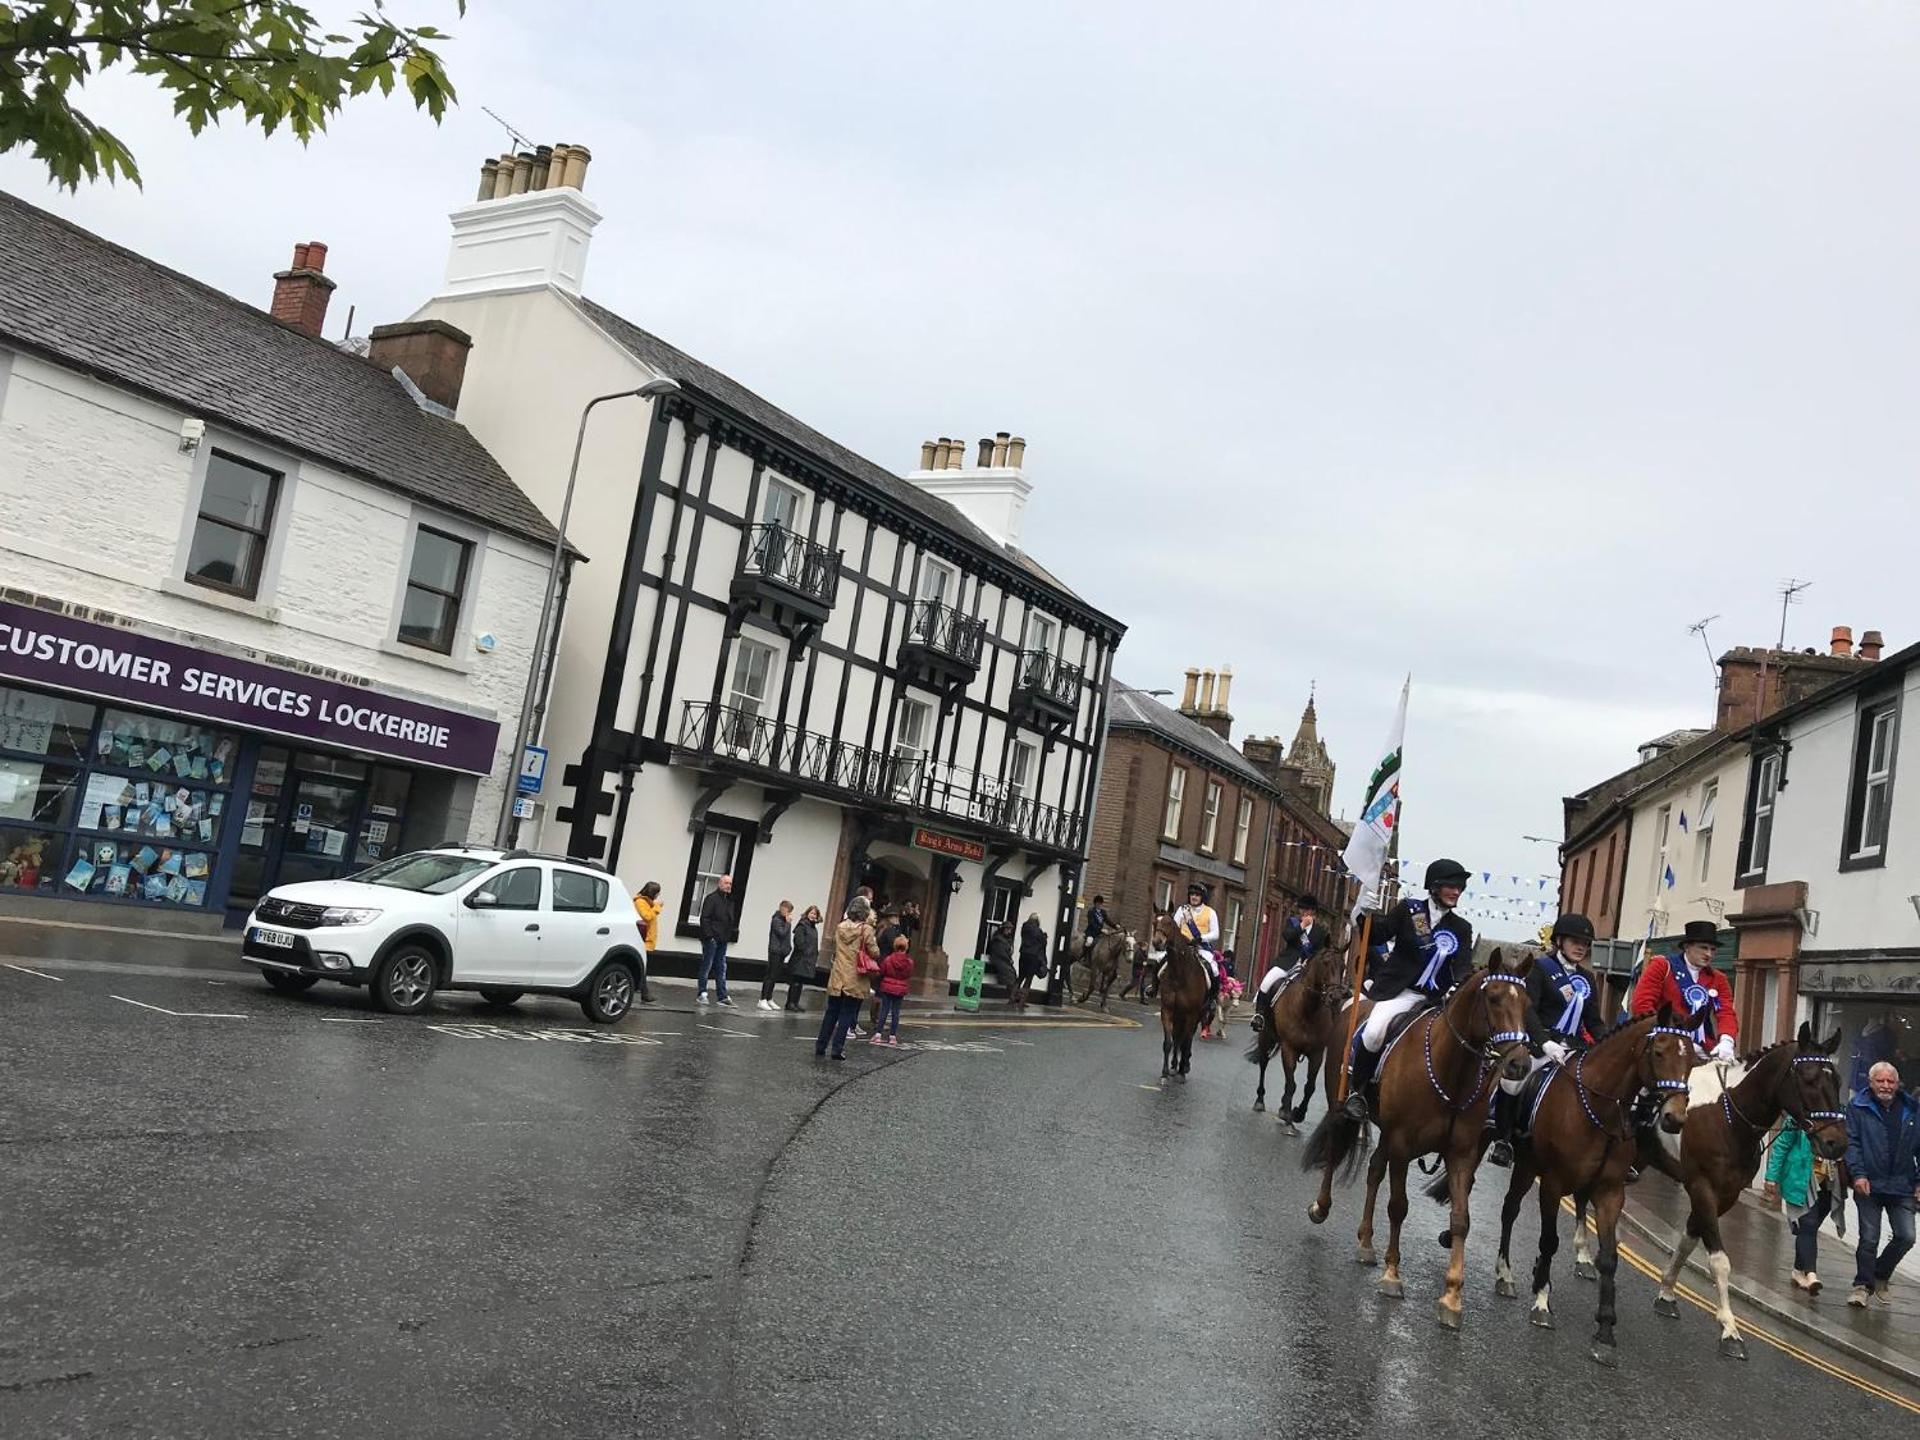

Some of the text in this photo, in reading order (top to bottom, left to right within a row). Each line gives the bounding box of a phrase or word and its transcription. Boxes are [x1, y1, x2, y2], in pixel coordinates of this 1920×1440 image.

[0, 623, 450, 748] CUSTOMER SERVICES LOCKERBIE
